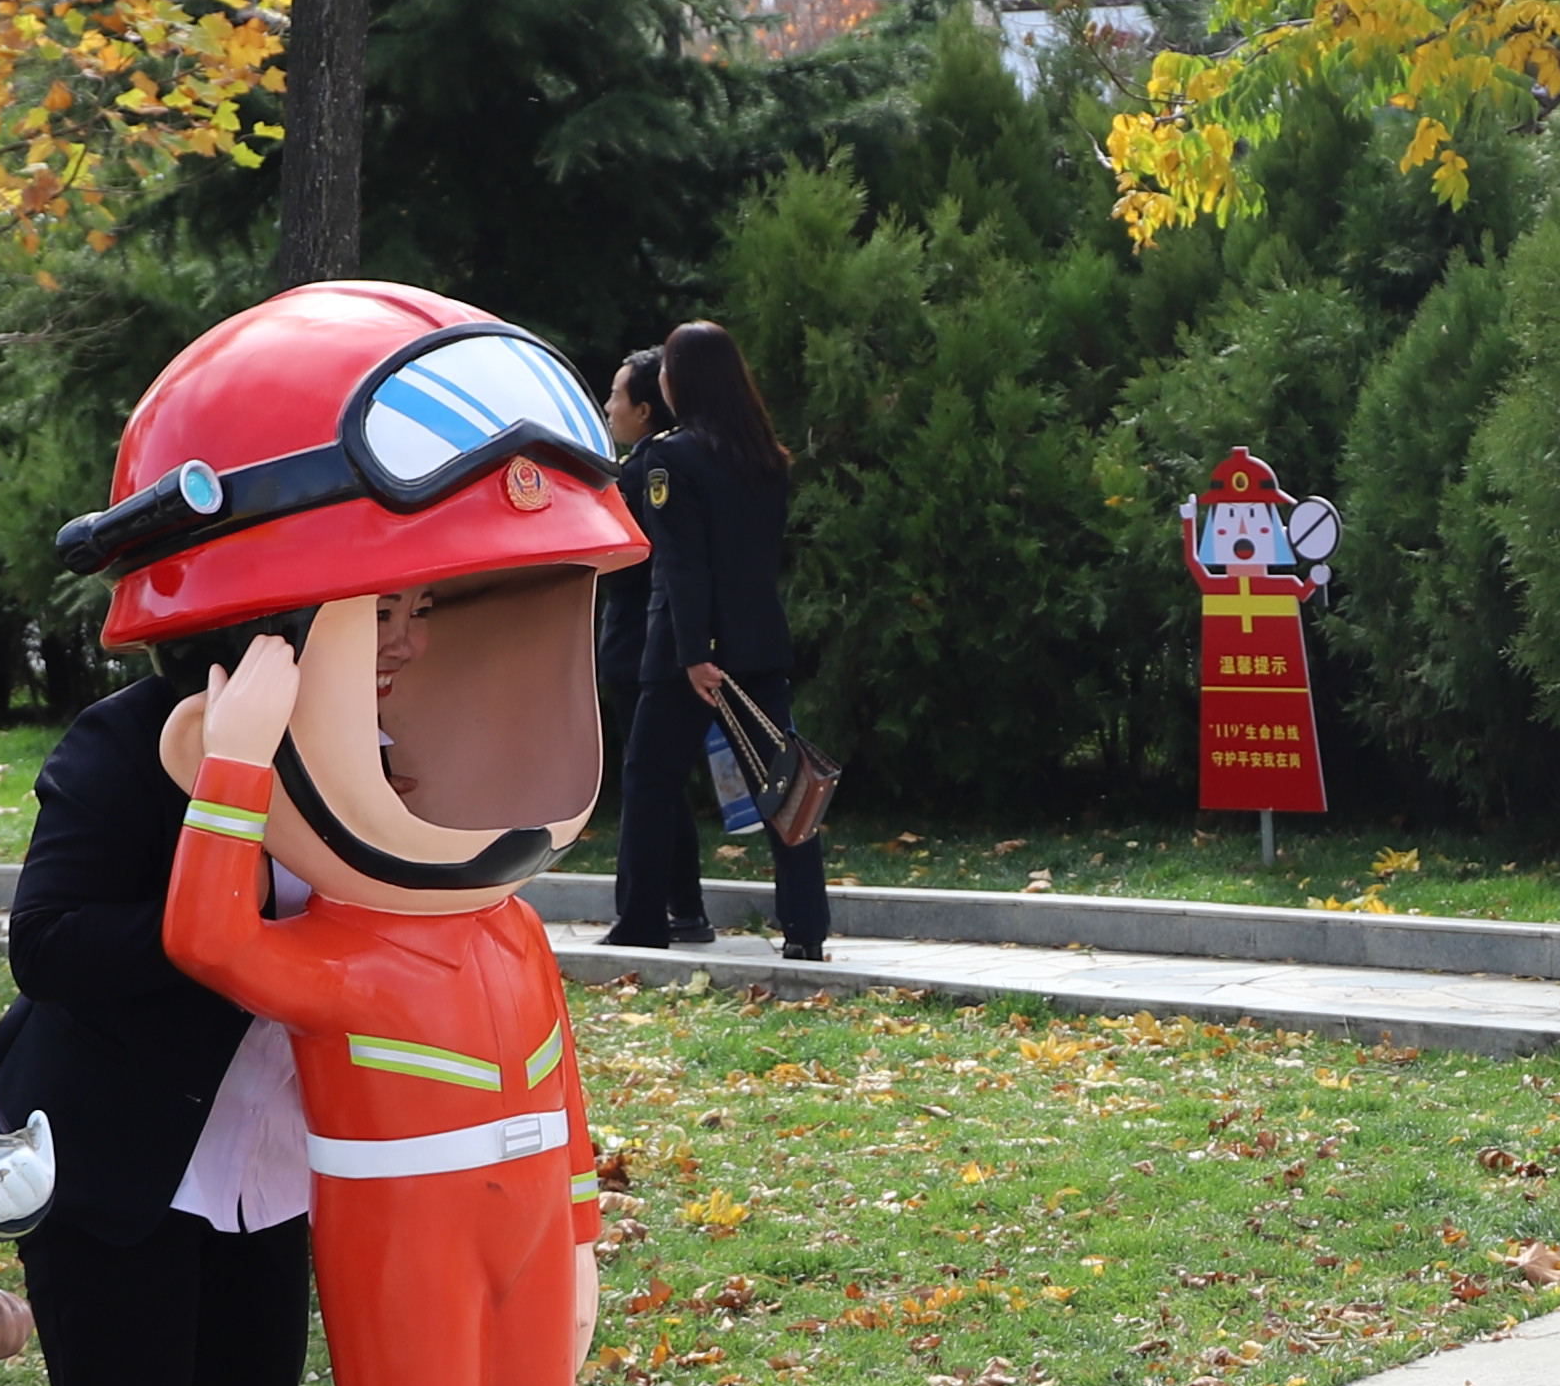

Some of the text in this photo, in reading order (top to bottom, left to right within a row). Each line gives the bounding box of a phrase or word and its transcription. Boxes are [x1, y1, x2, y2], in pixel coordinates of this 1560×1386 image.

[1219, 655, 1287, 675] 温馨提示
[1211, 750, 1301, 769] 守护平安我在岗
